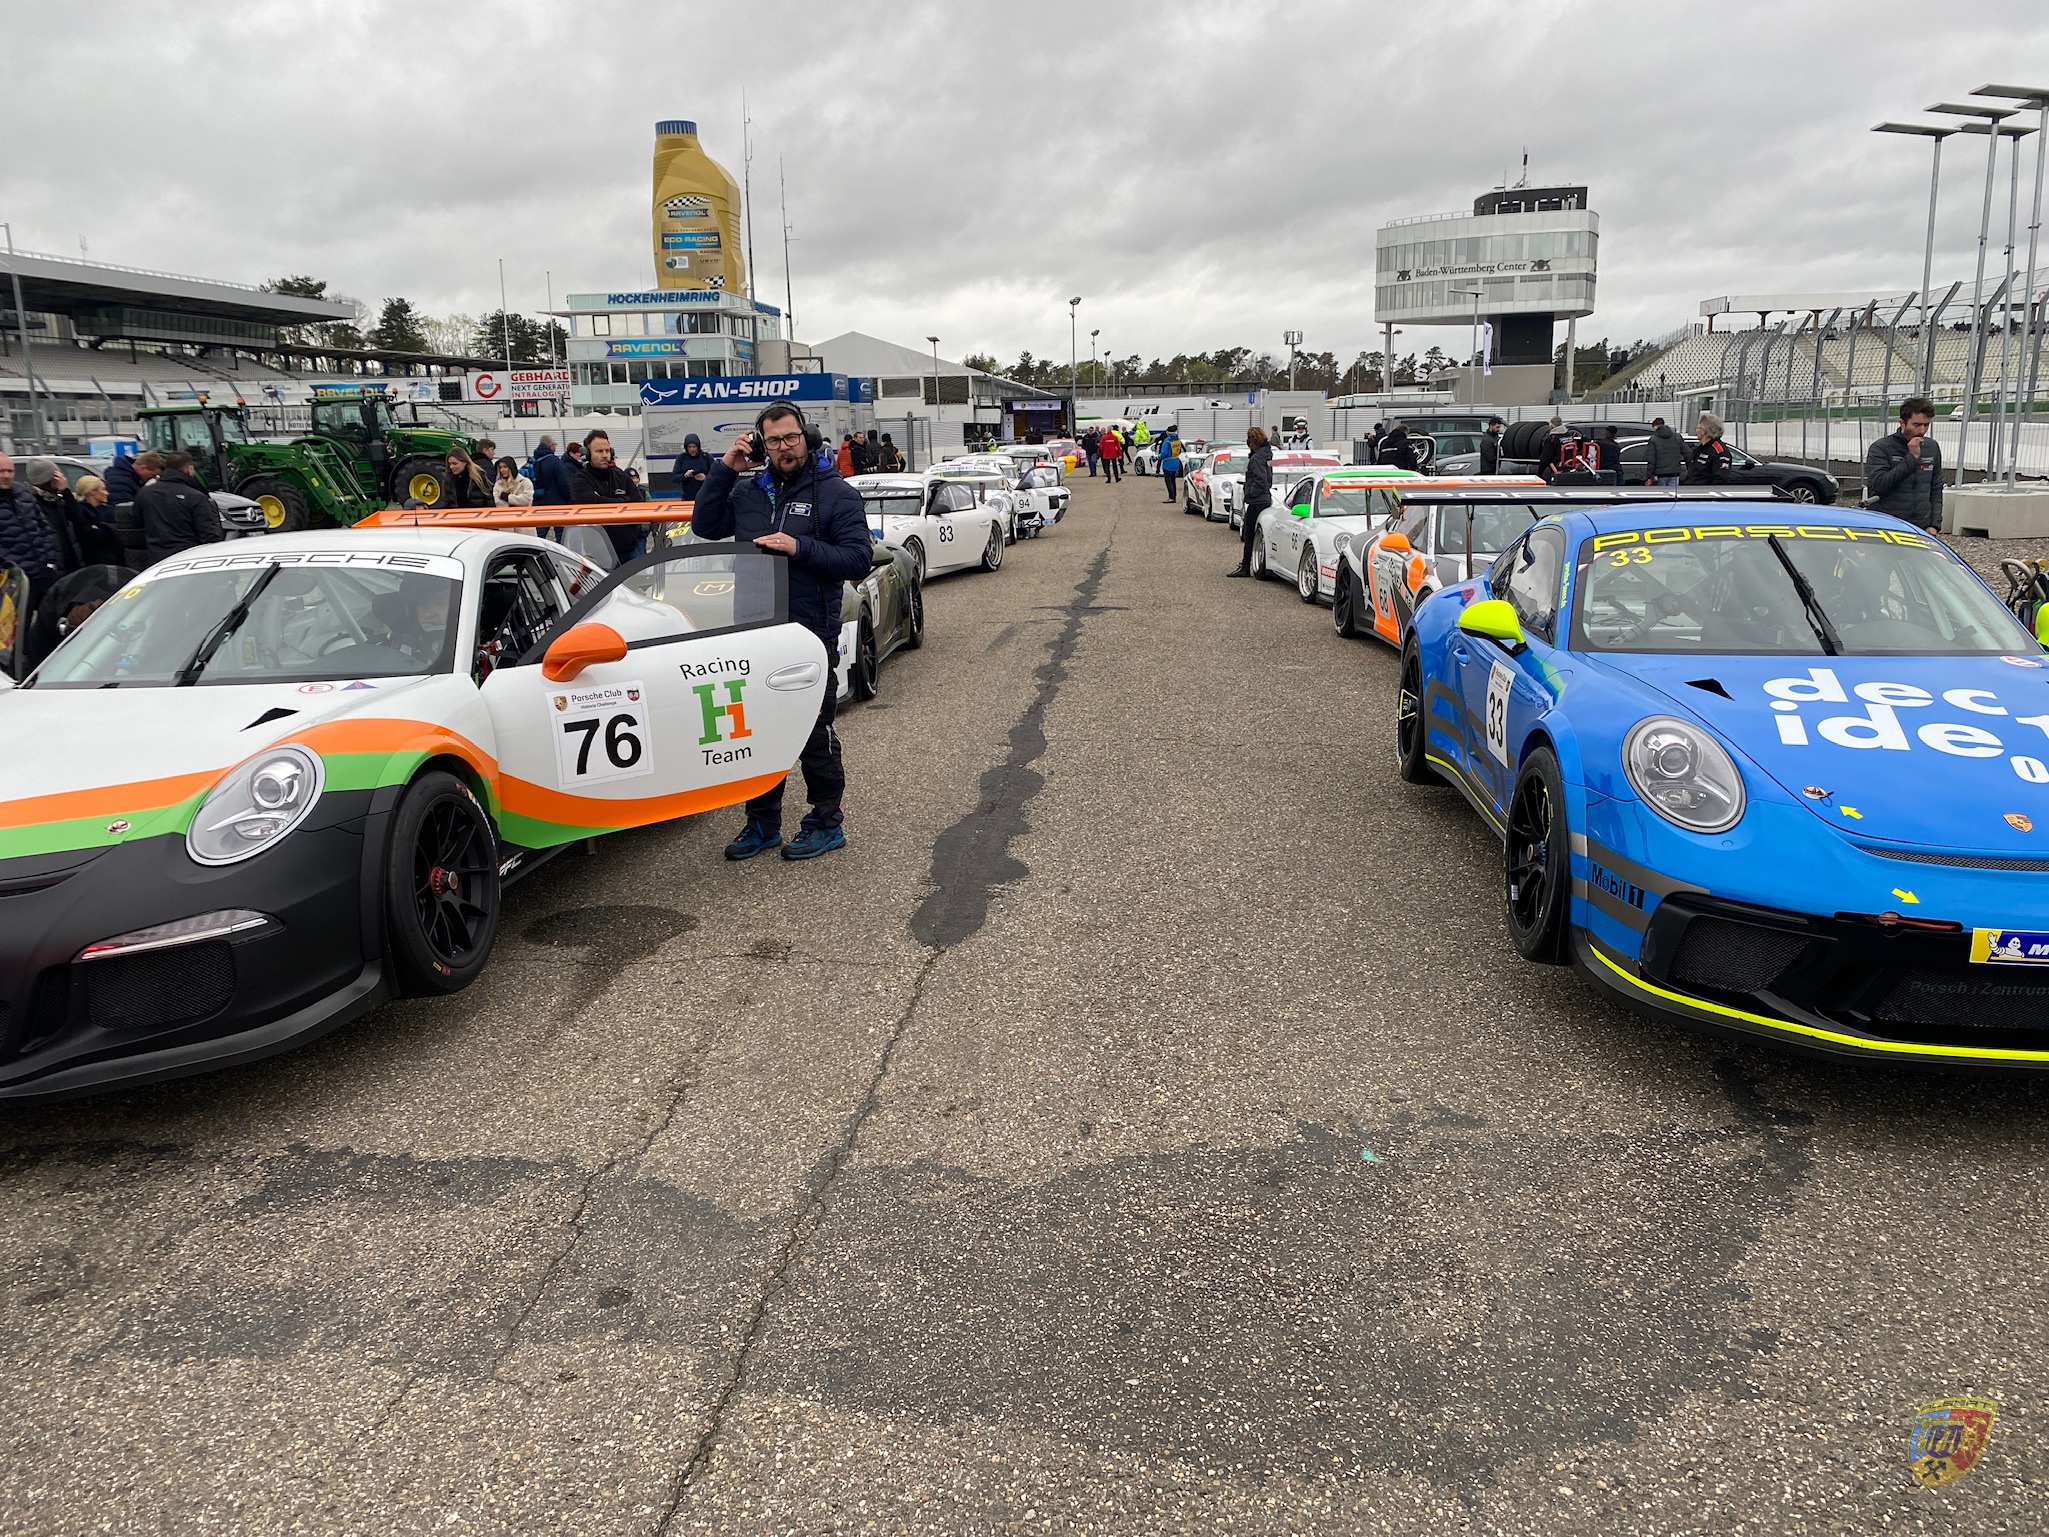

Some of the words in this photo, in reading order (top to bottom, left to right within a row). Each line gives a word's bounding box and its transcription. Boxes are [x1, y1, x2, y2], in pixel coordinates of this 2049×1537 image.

[670, 209, 707, 217] RAVENOL
[1415, 263, 1495, 277] Baden-Württemberg
[1497, 262, 1527, 272] Center
[607, 291, 721, 304] HOCKENHEIMRING
[612, 342, 680, 353] RAVENOL
[683, 380, 800, 399] FAN-SHOP
[1019, 498, 1030, 509] 94
[1405, 491, 1772, 499] PORSCHE
[396, 504, 695, 522] PORSCHE
[939, 525, 954, 543] 83
[1593, 525, 1932, 552] PORSCHE
[155, 553, 430, 577] PORSCHE
[1608, 548, 1653, 567] 33
[679, 657, 750, 680] Racing
[571, 691, 603, 703] Porsche
[604, 689, 622, 698] Club
[1763, 668, 2009, 715] dec
[1488, 691, 1503, 748] 33
[1769, 700, 2005, 758] ide
[563, 713, 642, 776] 76
[702, 746, 752, 765] Team
[1592, 863, 1626, 901] Mobil
